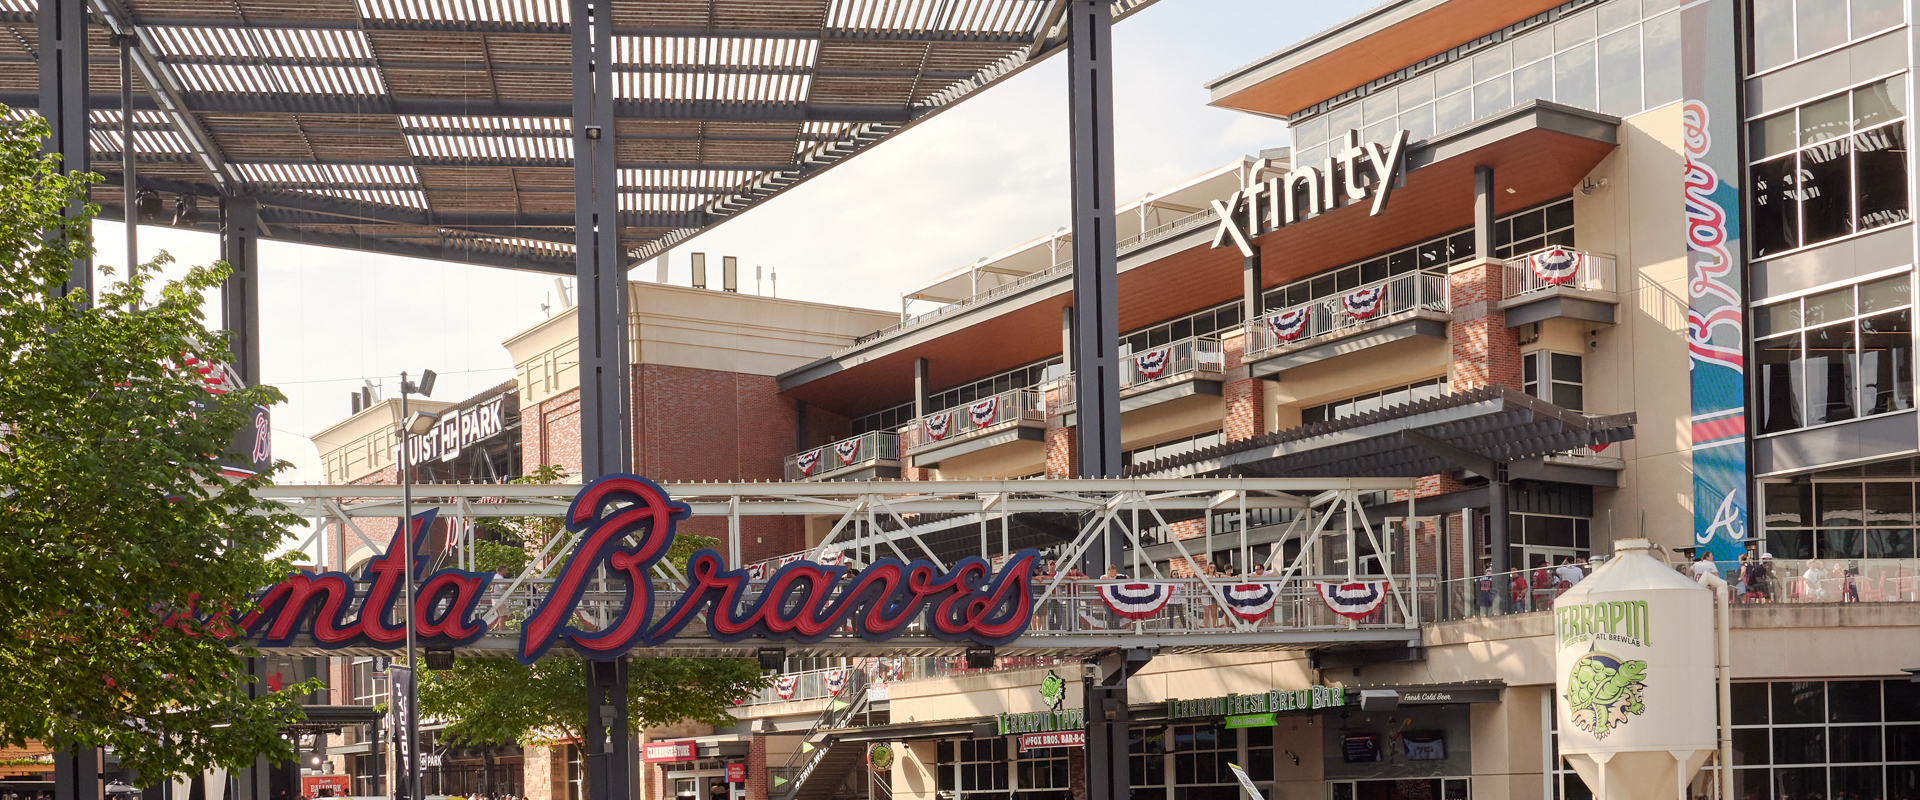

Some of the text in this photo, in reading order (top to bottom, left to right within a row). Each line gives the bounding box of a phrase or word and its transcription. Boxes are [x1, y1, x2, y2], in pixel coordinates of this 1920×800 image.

[1210, 129, 1410, 257] xfinity
[462, 400, 502, 446] PARK
[518, 473, 1041, 665] Braves
[1556, 600, 1650, 653] TERRAPIN
[1609, 634, 1641, 647] BREWLAB
[1165, 685, 1343, 720] TERRAPIN FRESH BREW BAR
[1404, 693, 1421, 701] Fresh
[1421, 692, 1437, 701] Cold
[995, 711, 1053, 735] TERRAPIN
[427, 755, 442, 767] PARK
[674, 745, 690, 756] STORE
